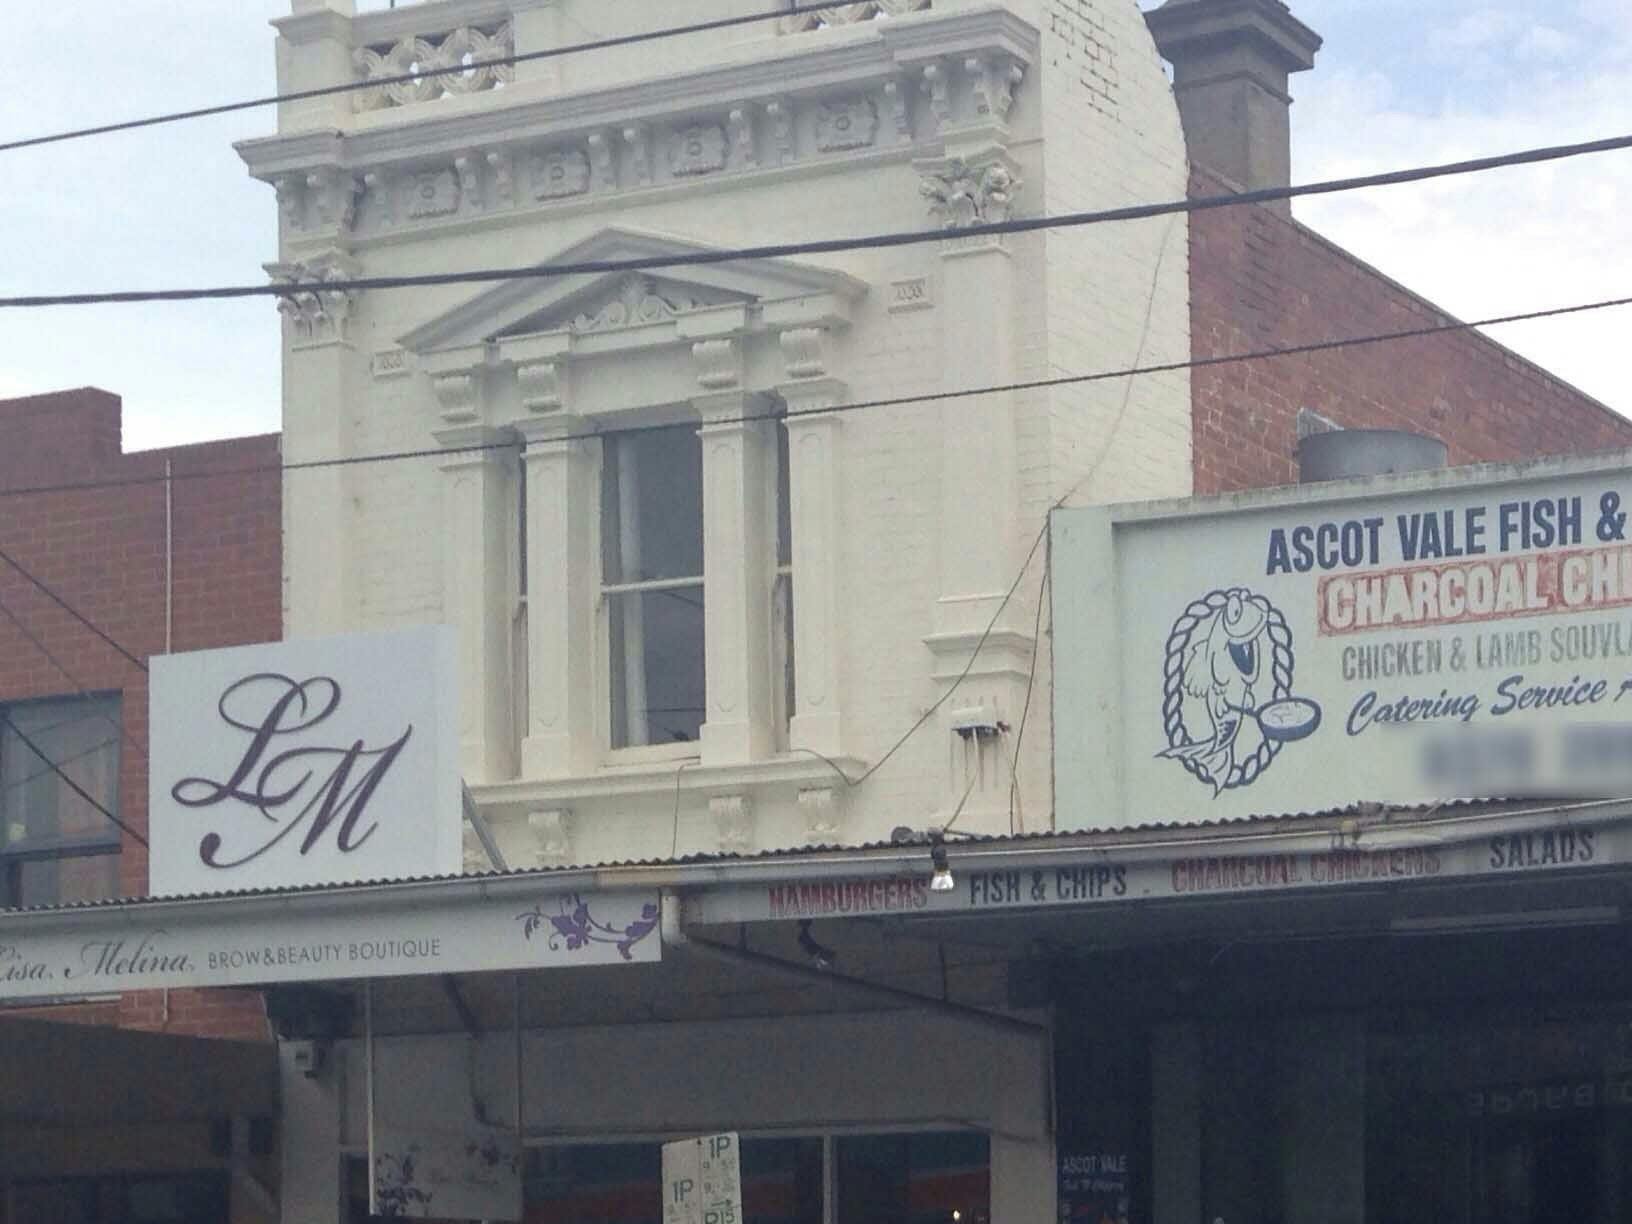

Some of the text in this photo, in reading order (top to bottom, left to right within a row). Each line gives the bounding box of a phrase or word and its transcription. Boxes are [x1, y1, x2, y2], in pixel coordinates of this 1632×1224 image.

[1266, 517, 1384, 575] ASCOT
[1397, 506, 1487, 561] VALE
[1500, 496, 1582, 551] FISH
[1596, 491, 1627, 542] &
[1325, 561, 1551, 630] CHARCOAL
[1341, 639, 1442, 682] CHICKEN
[1450, 636, 1468, 673] &
[1476, 629, 1541, 669] LAMB
[1346, 689, 1480, 736] Catering
[1491, 674, 1607, 715] Service
[768, 878, 928, 917] HAMBURGERS
[969, 871, 1021, 905] FISH
[1029, 868, 1047, 901] &
[1056, 864, 1128, 900] CHIPS
[1489, 829, 1594, 868] SALADS
[349, 937, 441, 961] BOUTIQUE
[708, 1136, 731, 1159] 1P
[672, 1178, 694, 1203] 1P
